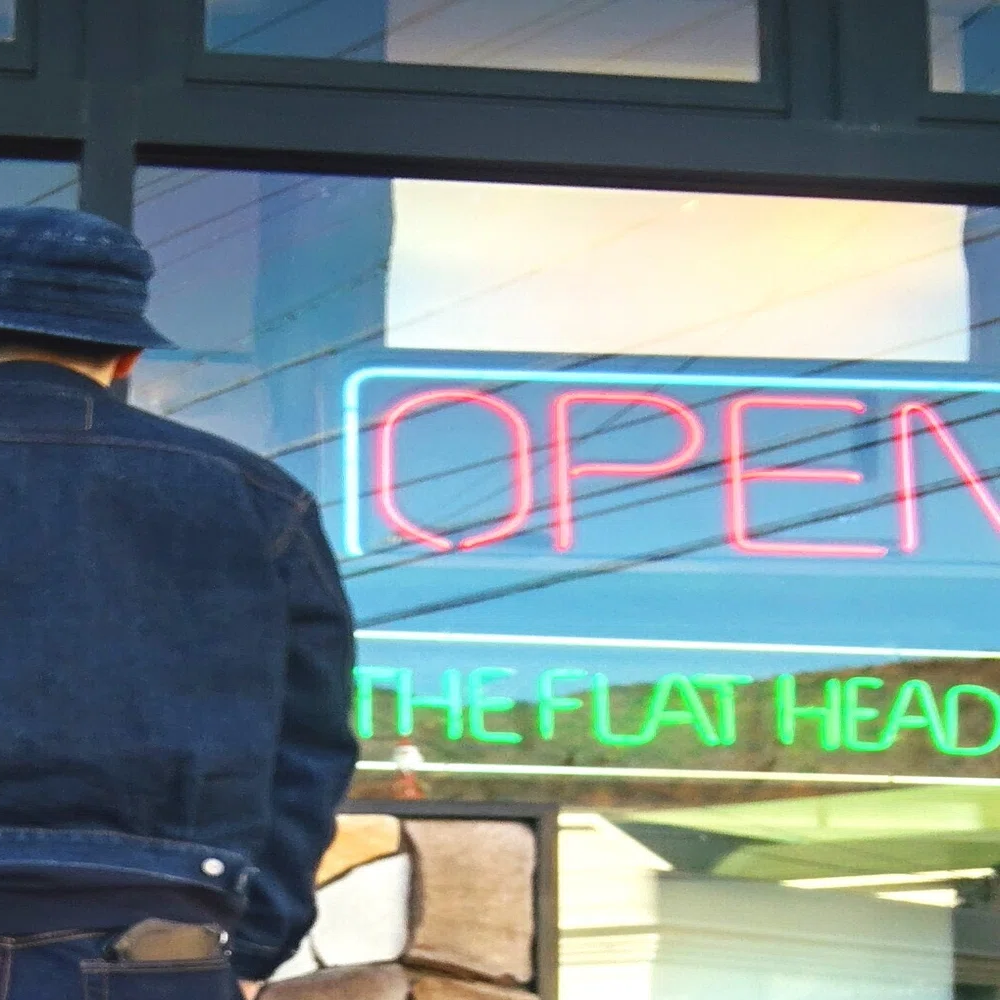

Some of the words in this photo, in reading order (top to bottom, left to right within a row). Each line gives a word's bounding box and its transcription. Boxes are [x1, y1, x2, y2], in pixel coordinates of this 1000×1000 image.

[353, 665, 523, 744] THE
[538, 667, 755, 748] FLAT
[774, 671, 1000, 757] HEAD
